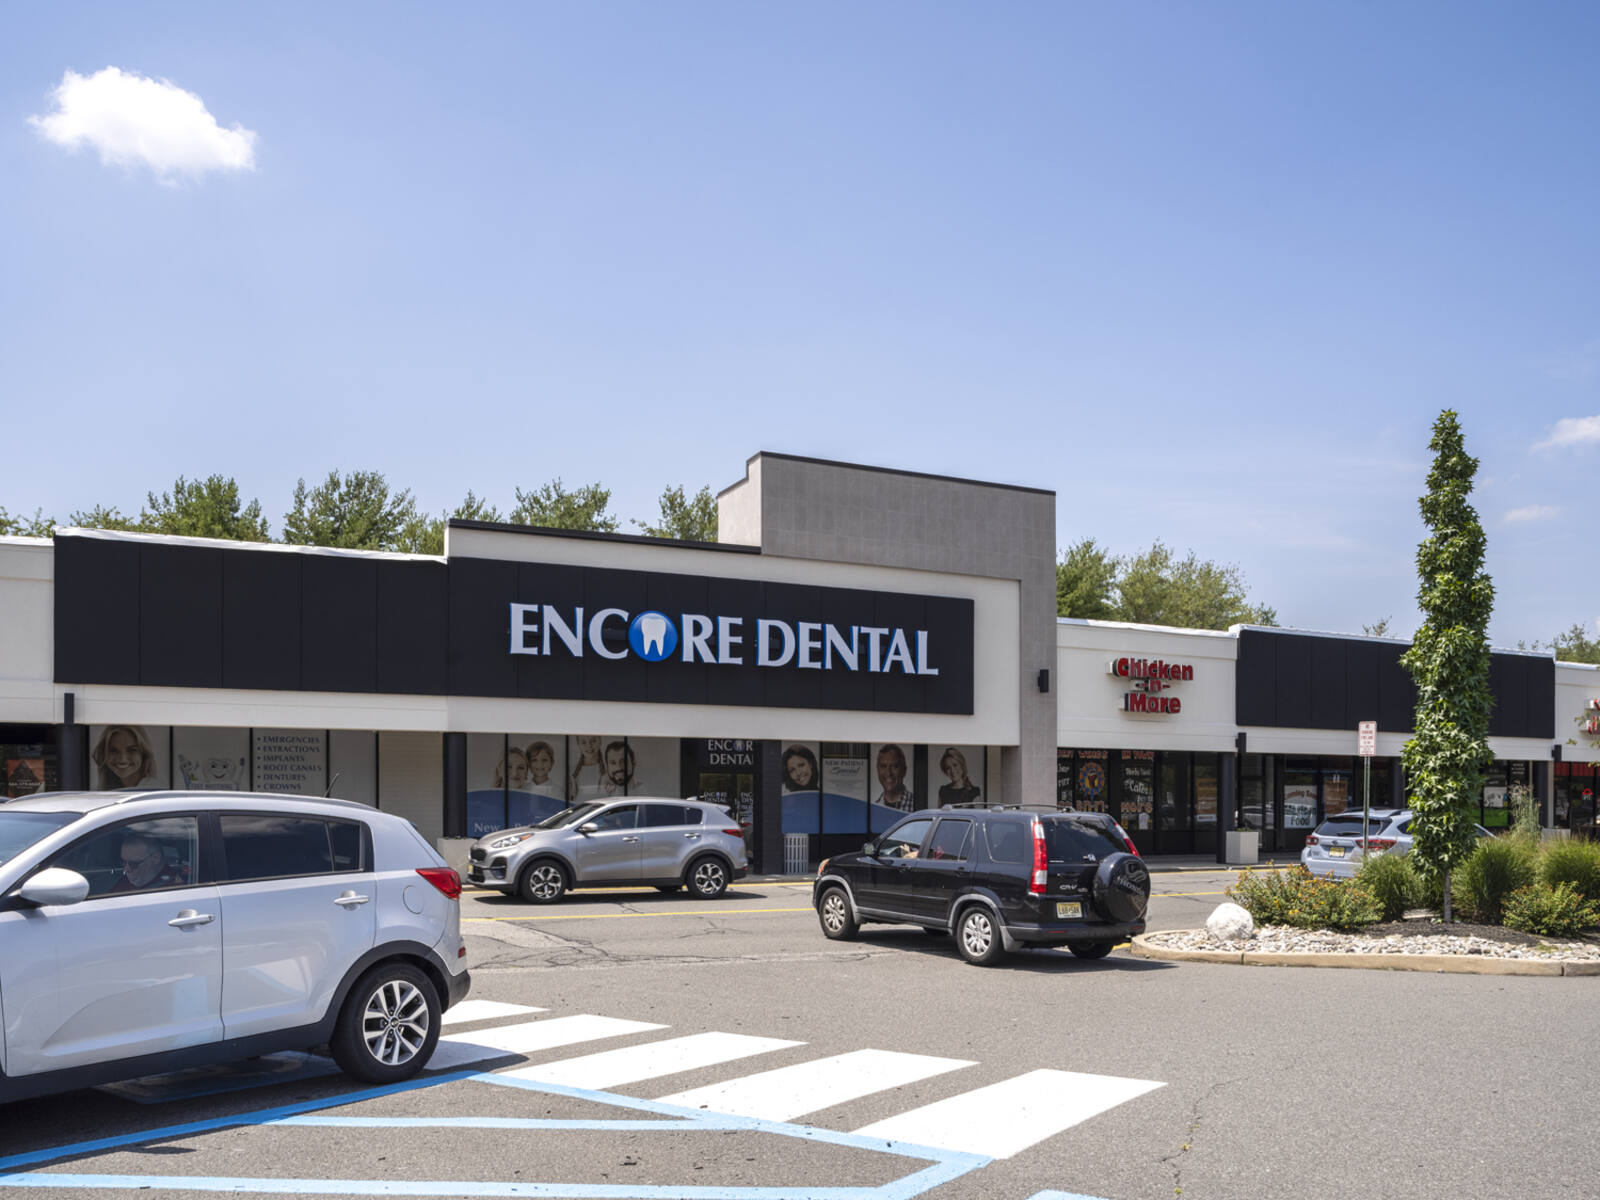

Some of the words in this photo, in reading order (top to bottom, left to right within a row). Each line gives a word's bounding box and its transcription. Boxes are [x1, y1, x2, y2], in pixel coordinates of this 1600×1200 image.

[756, 618, 939, 676] DENTAL
[1115, 657, 1193, 680] Chicken
[1127, 693, 1181, 713] More
[710, 753, 753, 765] DENTA
[474, 823, 500, 833] New
